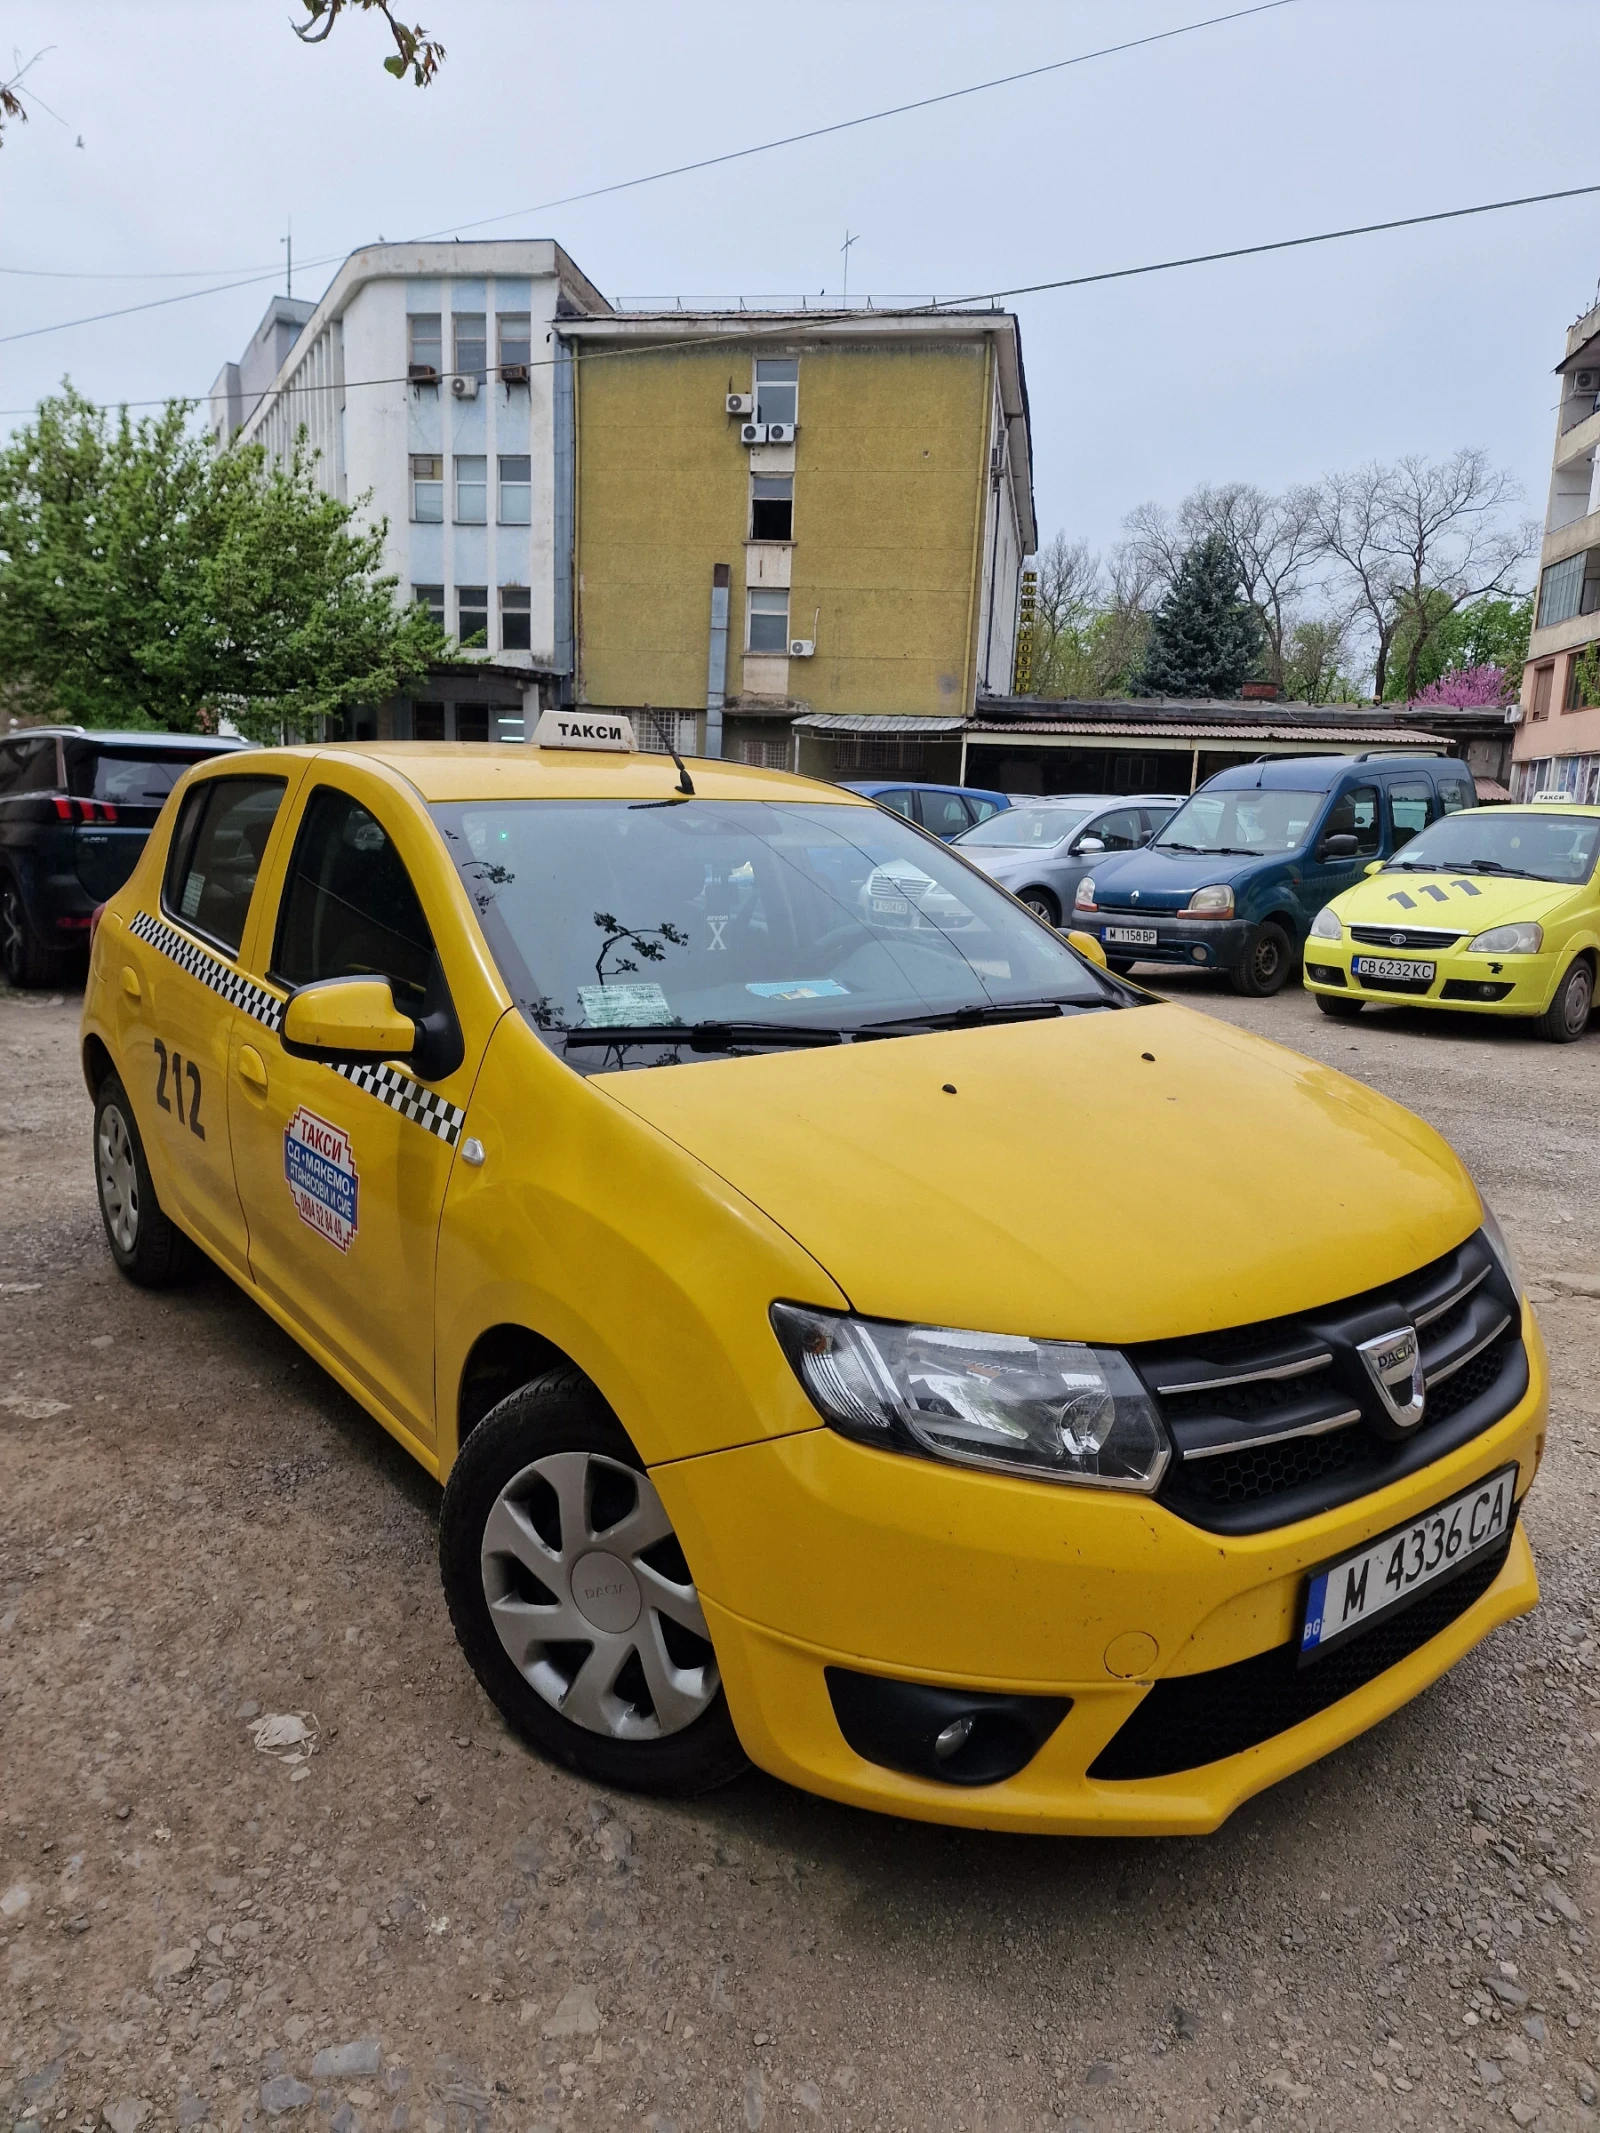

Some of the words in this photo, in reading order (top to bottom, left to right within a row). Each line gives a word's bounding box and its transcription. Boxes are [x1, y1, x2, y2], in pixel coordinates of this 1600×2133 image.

[558, 722, 622, 740] ТАКСИ
[1387, 880, 1483, 910] 111
[707, 922, 728, 950] X
[1109, 929, 1116, 939] M
[1121, 929, 1141, 941] 1158
[1143, 931, 1156, 942] BP
[1360, 960, 1376, 973] CB
[1378, 961, 1411, 976] 6232
[1413, 964, 1432, 978] KC
[154, 1037, 206, 1142] 212
[287, 1140, 300, 1163] СД
[301, 1119, 343, 1164] ТАКСИ
[290, 1161, 329, 1203] АТАНАСОВИ
[330, 1188, 337, 1207] И
[336, 1194, 352, 1218] СИЕ
[1378, 1344, 1415, 1368] DACIA
[1304, 1619, 1321, 1640] BG
[1342, 1559, 1370, 1622] M
[1385, 1507, 1462, 1591] 4336
[1469, 1482, 1504, 1545] CA
[584, 1584, 627, 1599] DACIA
